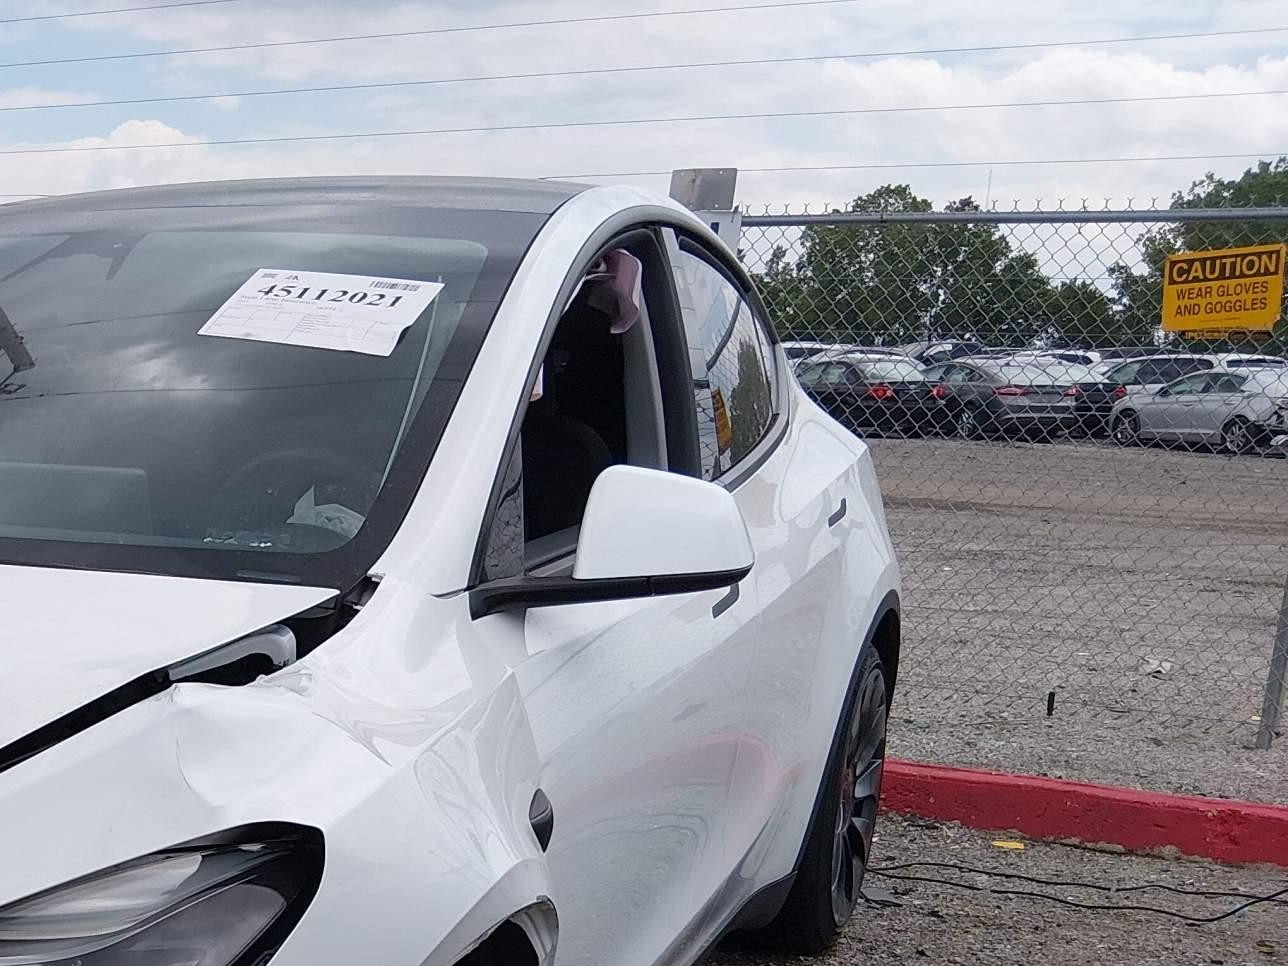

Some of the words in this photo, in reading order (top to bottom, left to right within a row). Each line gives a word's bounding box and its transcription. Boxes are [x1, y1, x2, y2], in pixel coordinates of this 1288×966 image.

[1172, 254, 1276, 282] CAUTION
[257, 284, 403, 308] 45112021
[1176, 286, 1212, 301] WEAR
[1216, 280, 1269, 298] GLOVES
[1175, 303, 1201, 317] AND
[1204, 297, 1267, 315] GOGGLES
